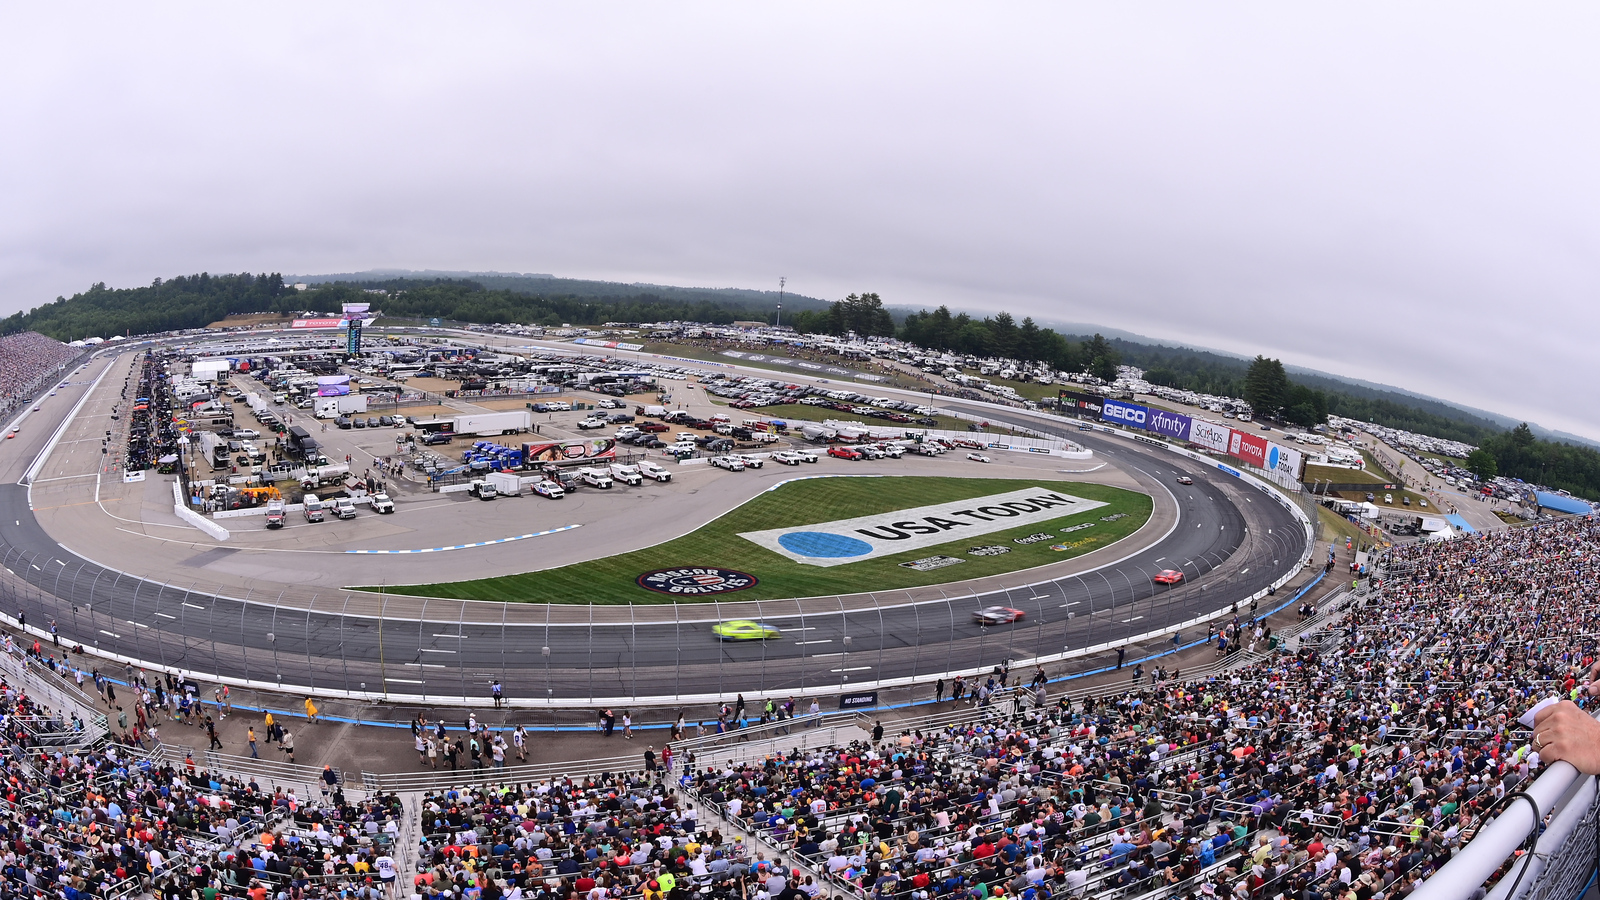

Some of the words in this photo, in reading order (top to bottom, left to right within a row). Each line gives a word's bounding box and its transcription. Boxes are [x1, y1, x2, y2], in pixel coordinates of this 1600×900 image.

[1103, 403, 1146, 424] GEICO
[1151, 412, 1186, 437] xfinity
[1195, 424, 1223, 445] SciAps
[1241, 441, 1263, 458] TOYOTA
[1279, 451, 1289, 462] USA
[1278, 461, 1294, 476] TODAY
[854, 516, 974, 541] USA
[951, 494, 1077, 521] TODAY
[647, 568, 719, 582] NASCAR
[668, 578, 749, 594] SALUTES
[852, 696, 873, 704] STANDING
